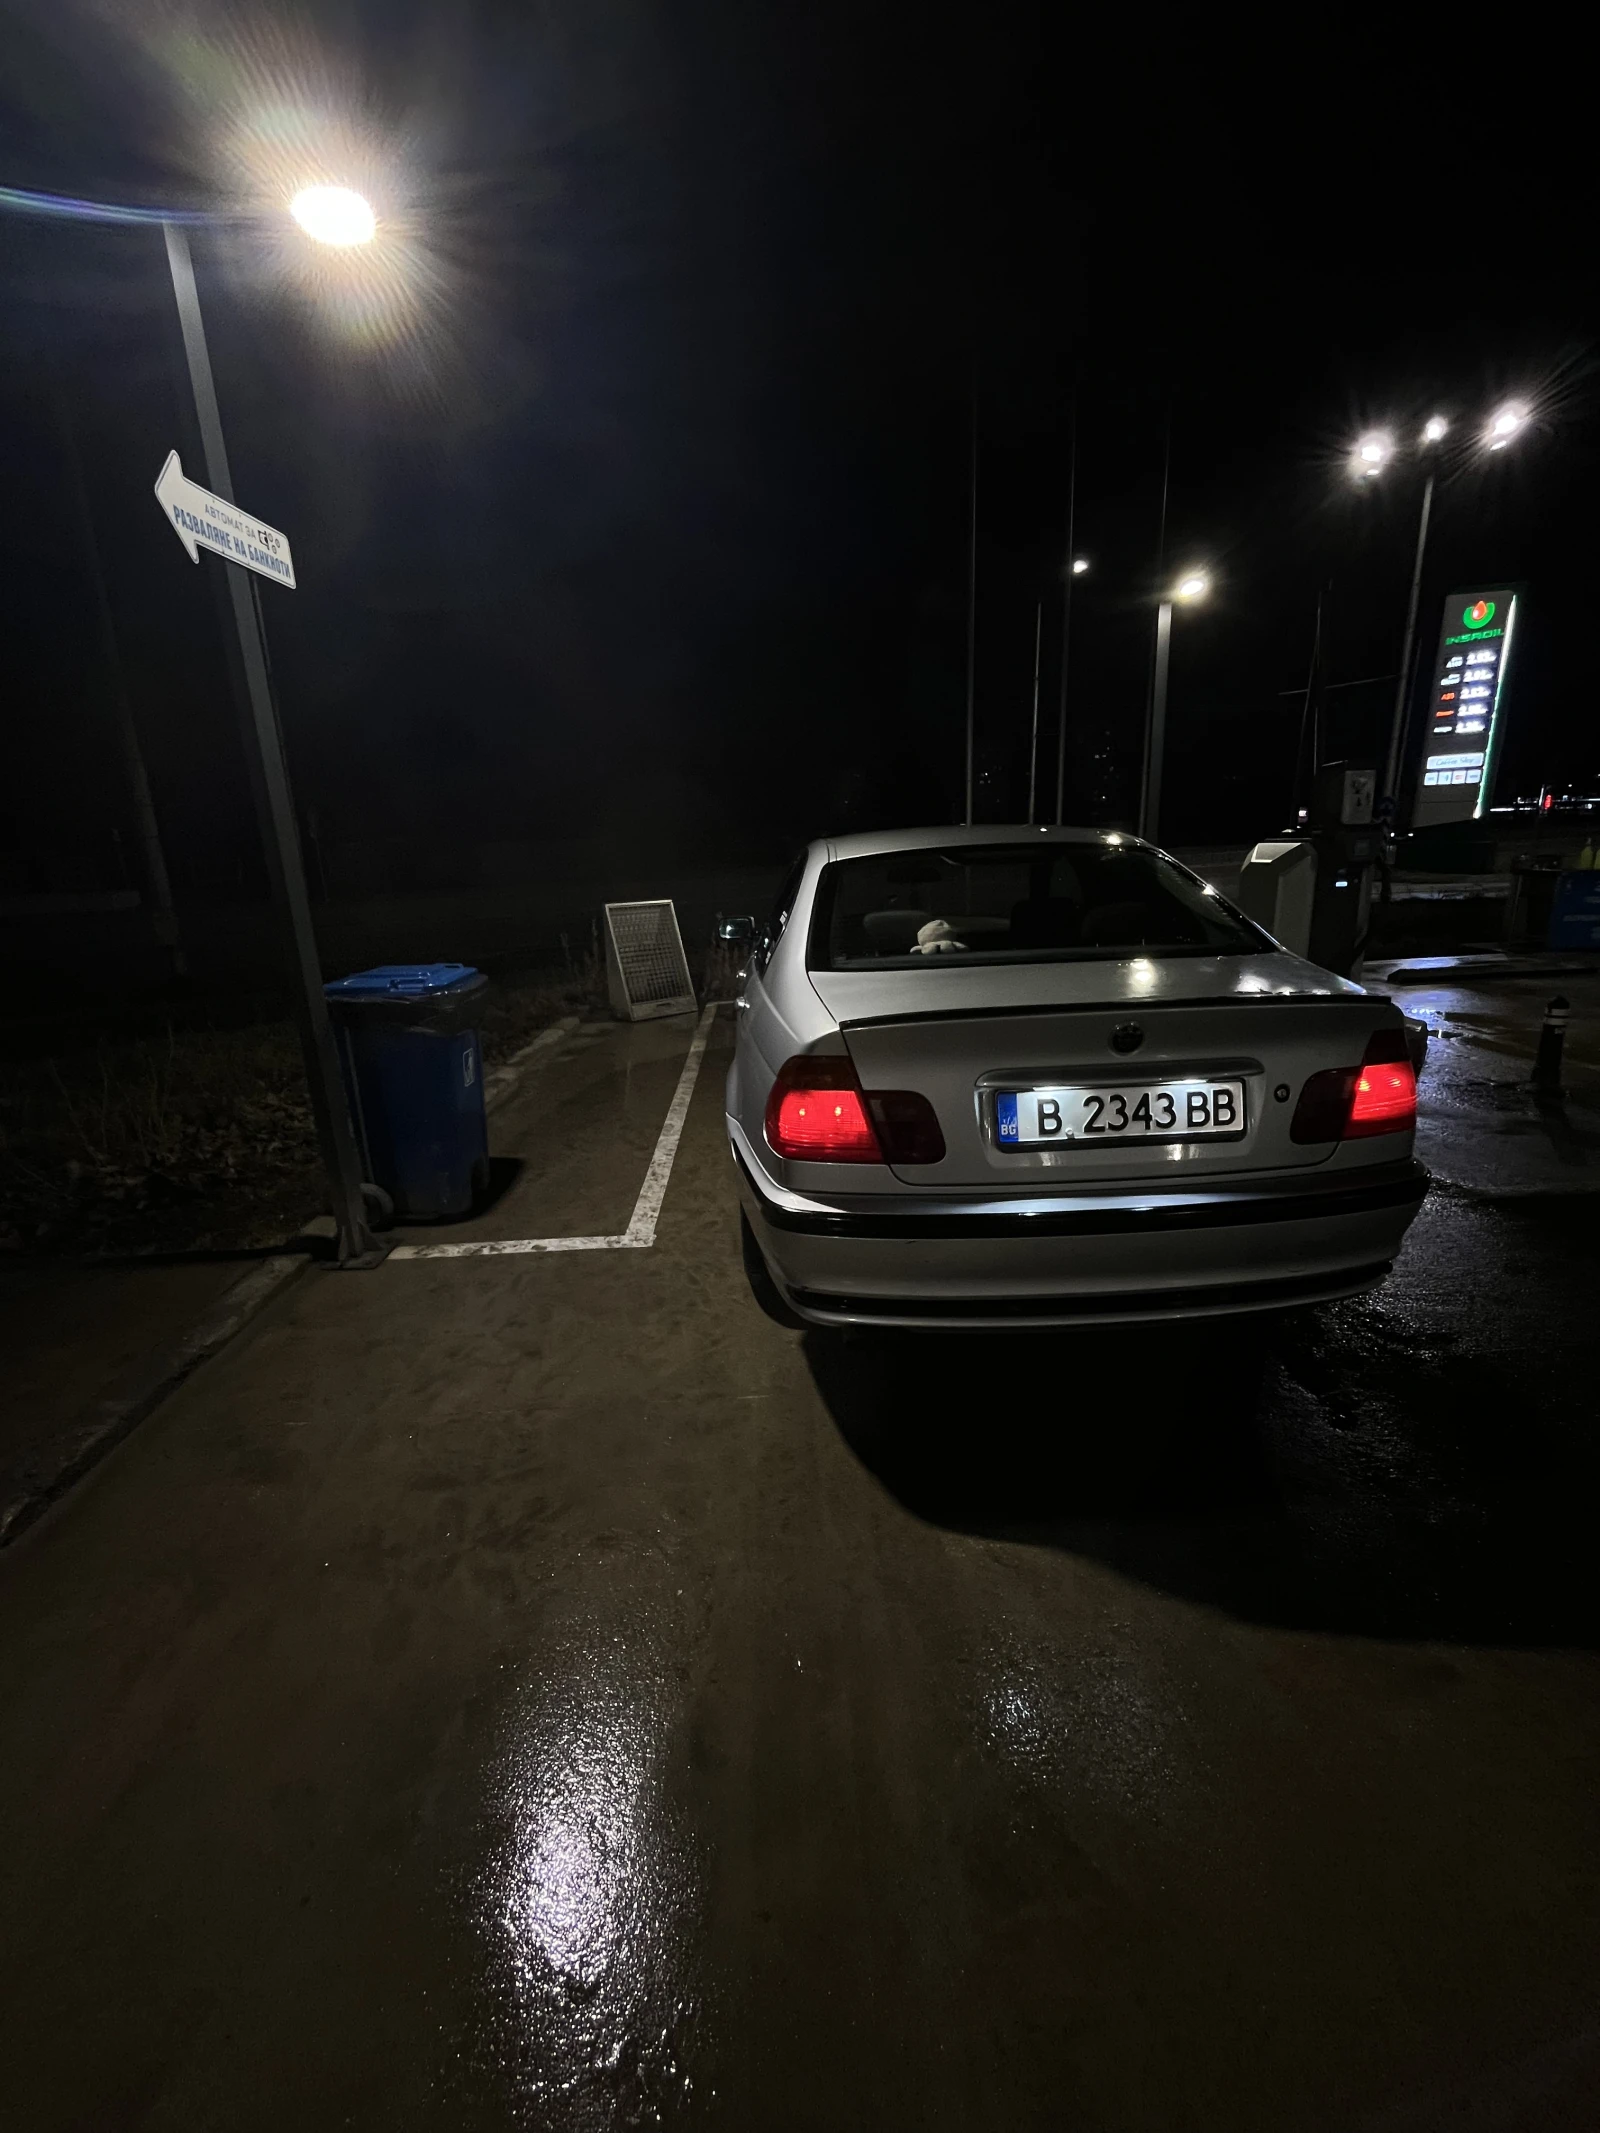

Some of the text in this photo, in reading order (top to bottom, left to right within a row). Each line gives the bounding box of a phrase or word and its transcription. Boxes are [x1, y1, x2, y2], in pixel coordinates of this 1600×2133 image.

[173, 504, 291, 579] РАЗВАЛЯНЕ НА БАНКНОТИ
[205, 504, 257, 540] АВТОМАТ ЗА
[1000, 1123, 1017, 1136] BG
[1037, 1088, 1237, 1136] B 2343 BB
